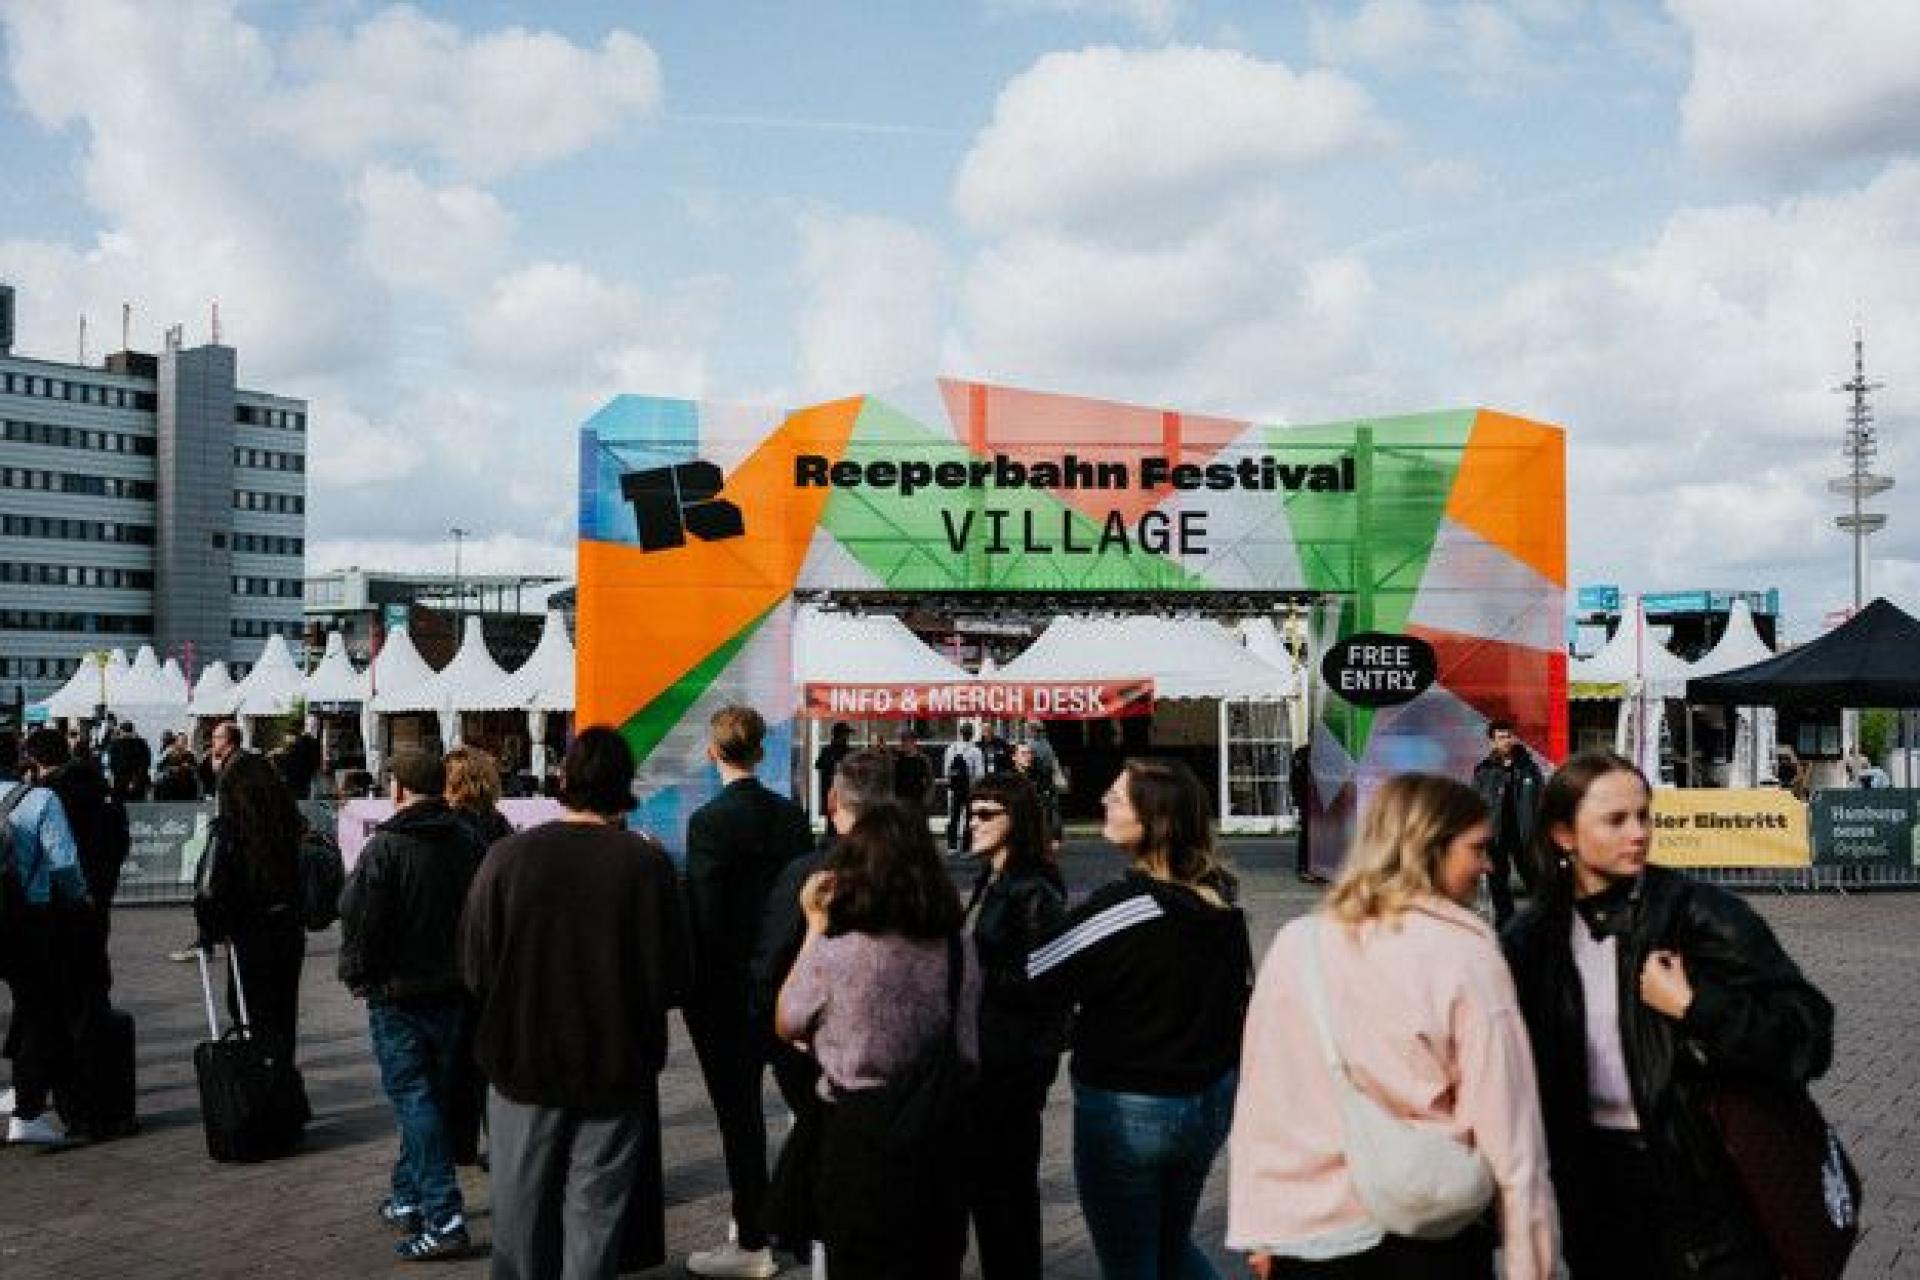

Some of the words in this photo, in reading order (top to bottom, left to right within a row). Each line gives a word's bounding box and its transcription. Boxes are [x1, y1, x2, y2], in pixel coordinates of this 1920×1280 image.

[795, 454, 1128, 496] Reeperbahn
[1140, 457, 1356, 492] Festival
[941, 508, 1210, 554] VILLAGE
[1347, 645, 1410, 666] FREE
[1340, 670, 1418, 690] ENTRY
[830, 687, 891, 712] INFO
[900, 687, 919, 712] &
[928, 686, 1025, 712] MERCH
[1033, 686, 1106, 712] DESK
[1654, 811, 1690, 829] ier
[1694, 811, 1789, 829] Eintritt
